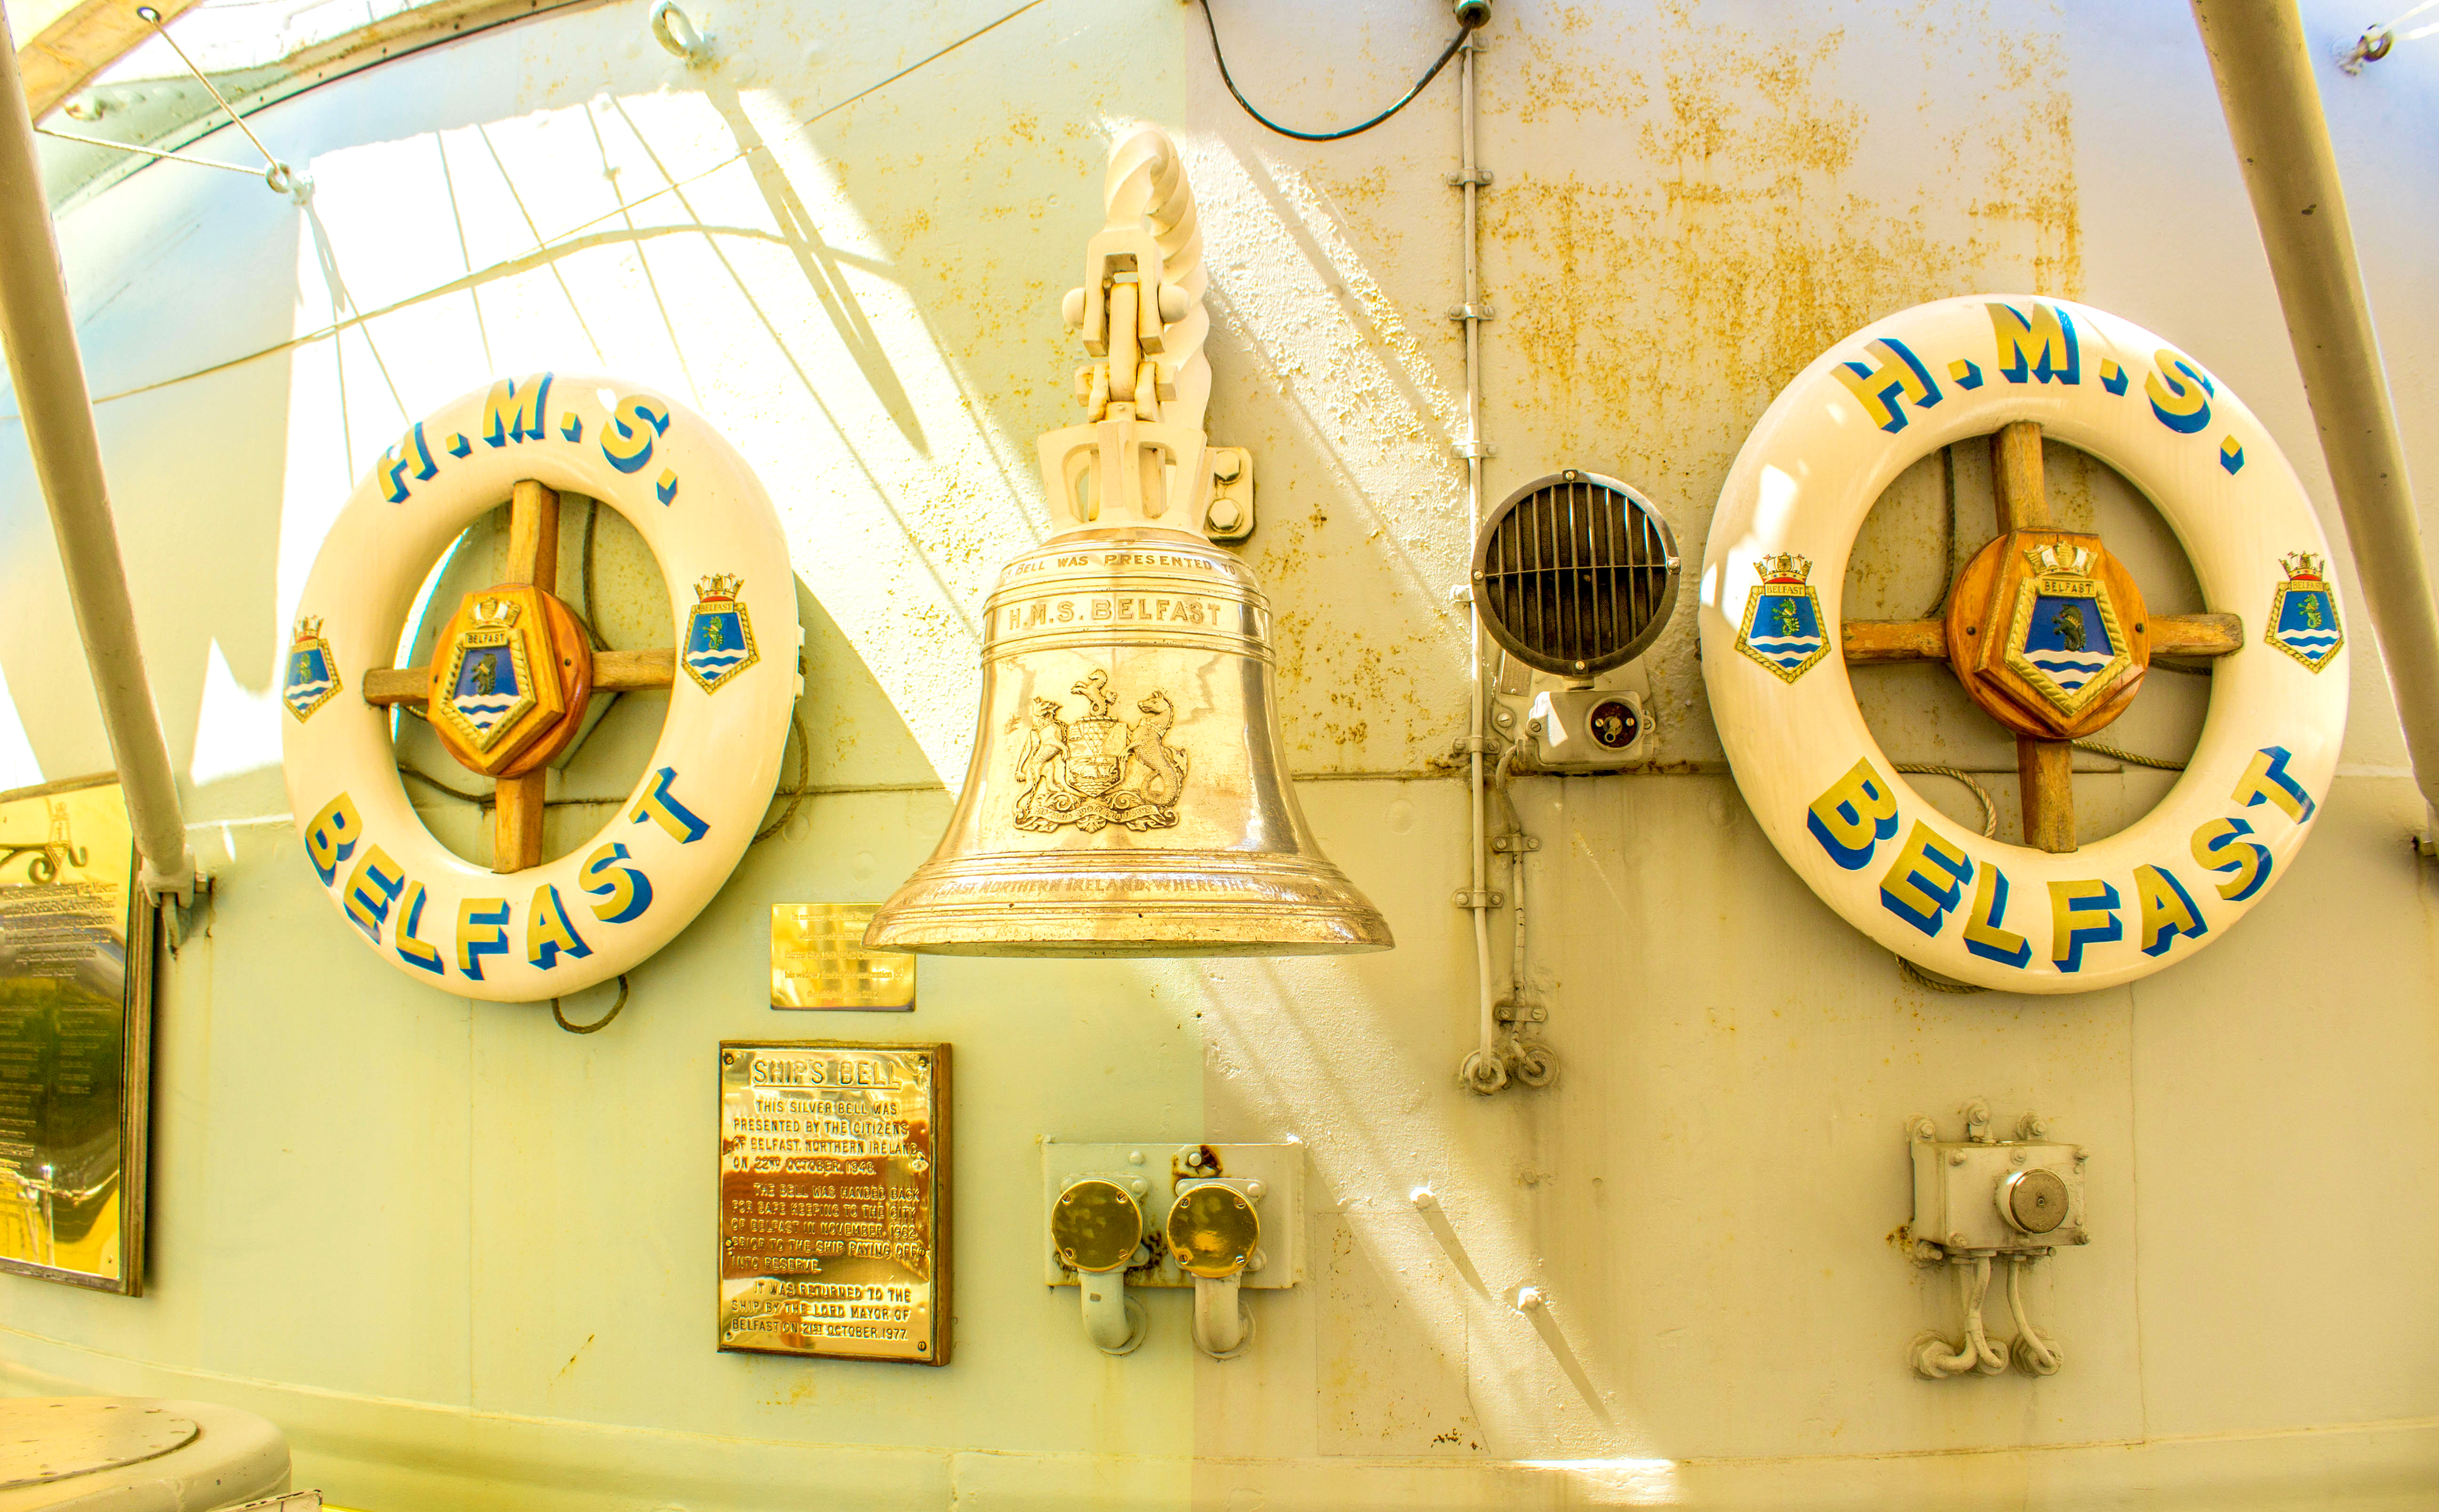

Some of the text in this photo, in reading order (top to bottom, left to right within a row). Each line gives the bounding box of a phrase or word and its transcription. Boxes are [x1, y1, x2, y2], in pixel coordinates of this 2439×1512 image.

[1829, 302, 2245, 475] H.M.S.
[1015, 561, 1045, 575] BELL
[1058, 556, 1088, 567] WAS
[1105, 554, 1212, 570] PRESENTED
[1221, 563, 1235, 575] TO
[1767, 586, 1803, 595] BELFAST
[2045, 581, 2092, 593] BELFAST
[1091, 598, 1220, 625] BELFAST
[468, 633, 504, 644] BELFAST
[1807, 746, 2315, 973] BELFAST
[306, 766, 710, 980] BELFAST
[980, 879, 1062, 894] NORTHERN
[1153, 878, 1217, 892] WHERE
[754, 1059, 900, 1086] SHIP'S BELL
[757, 1100, 898, 1115] THIS SILVER BELL WAS
[734, 1118, 908, 1135] PRESENTED BY THE CITIZENS
[733, 1137, 746, 1151] OF
[805, 1139, 864, 1154] NORTHERN
[733, 1157, 749, 1170] ON
[754, 1184, 920, 1202] THE BELL WAS HANDED BACK
[732, 1200, 916, 1219] FOR SAFE KEEPING TO THE CITY
[731, 1218, 745, 1231] OF
[751, 1219, 799, 1234] BELFAST
[804, 1222, 815, 1235] IN
[732, 1236, 918, 1258] PRIOR TO THE SHIP PAYING OFF
[732, 1256, 758, 1269] INTO
[754, 1282, 911, 1303] IT WAS RETURNED TO THE
[732, 1300, 911, 1322] SHIP BY THE LORD MAYOR OF
[732, 1319, 780, 1332] BELFAST
[783, 1322, 797, 1333] ON
